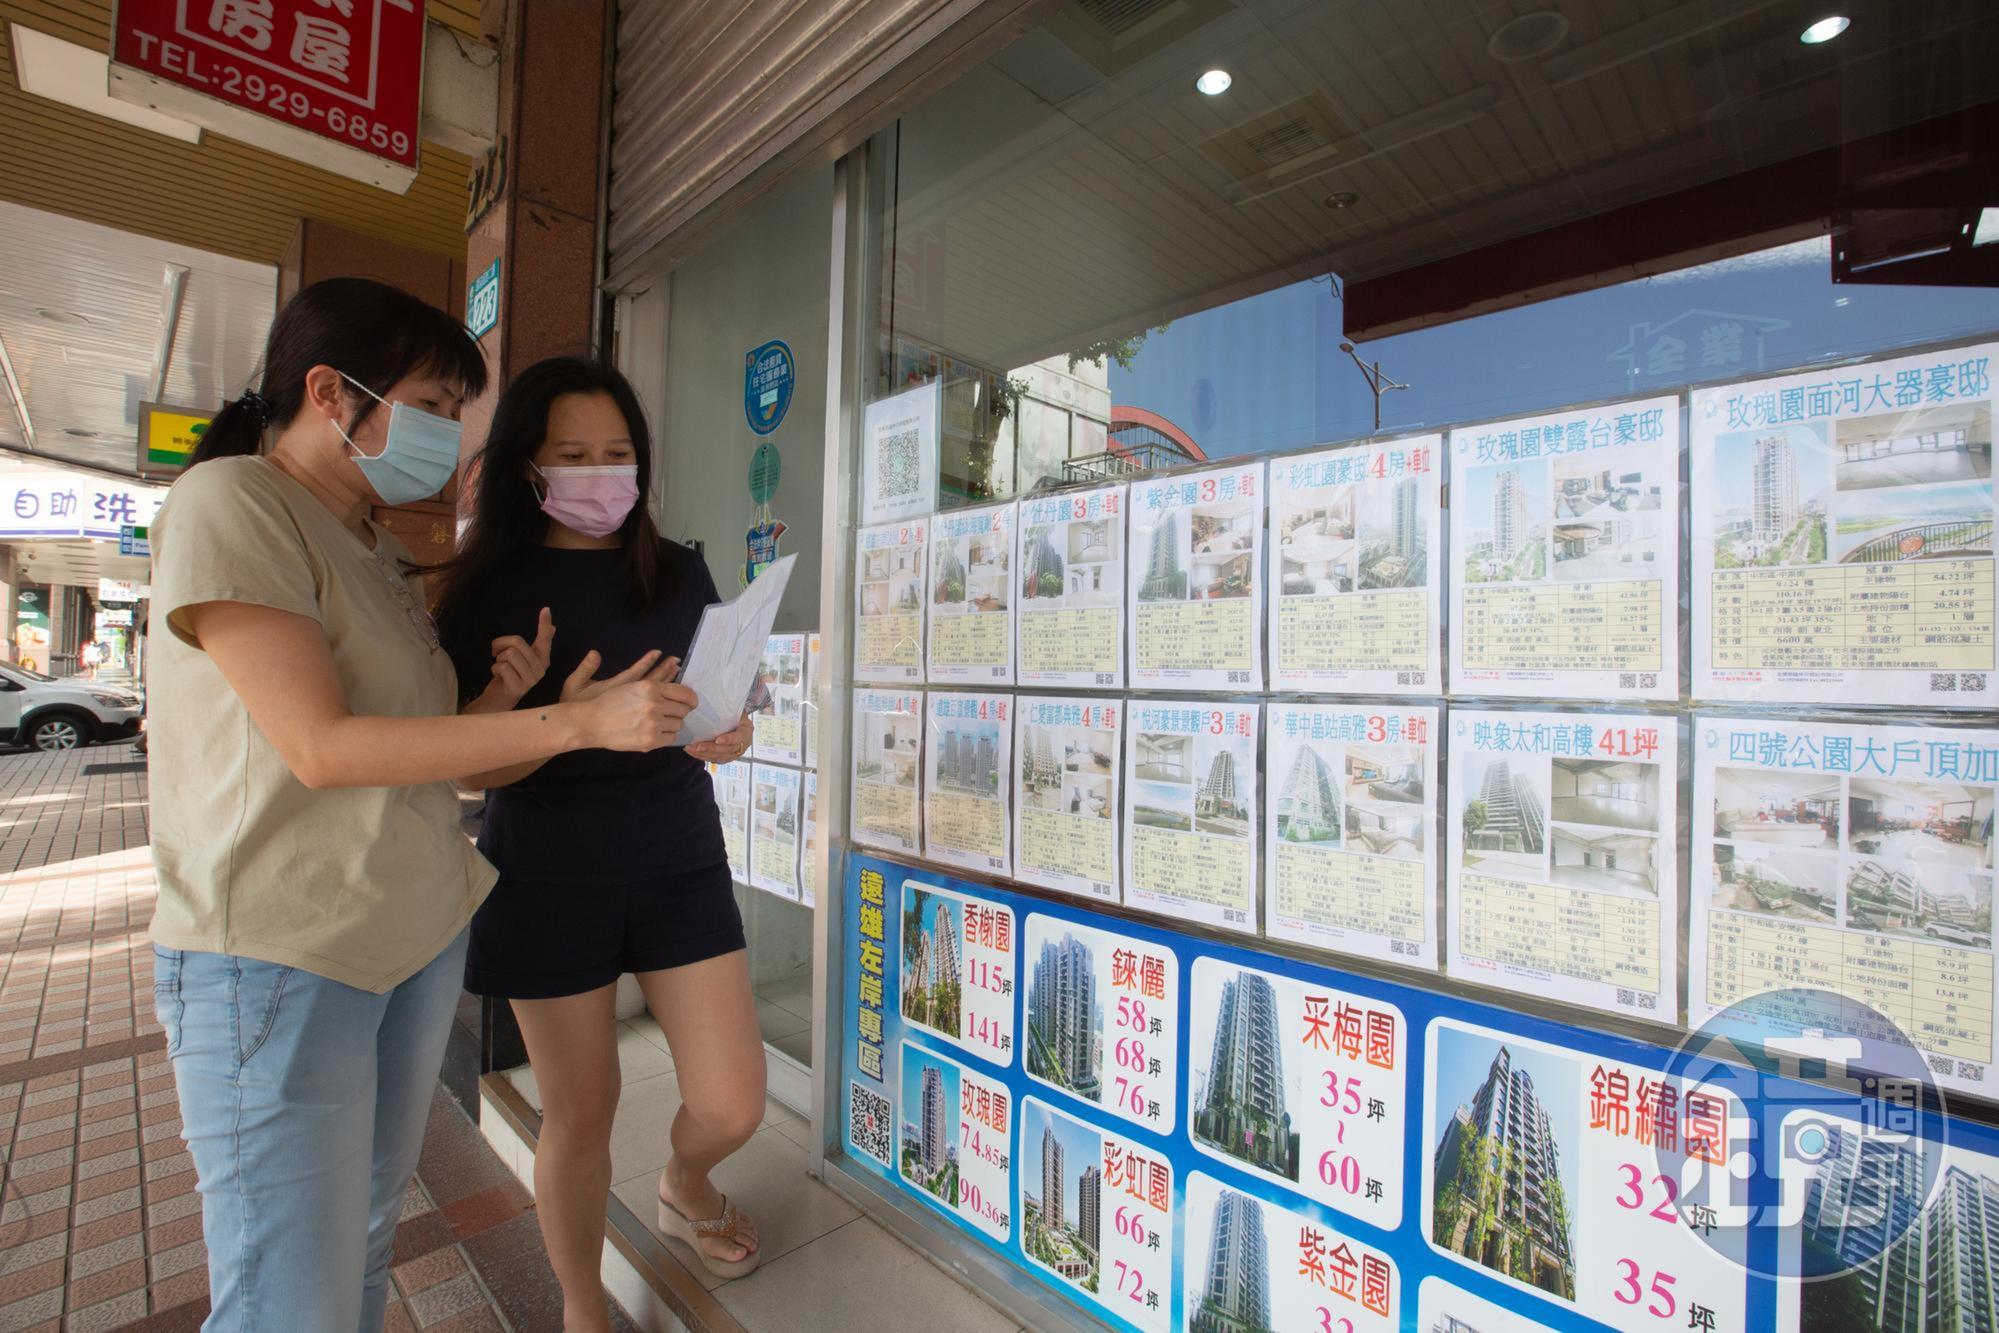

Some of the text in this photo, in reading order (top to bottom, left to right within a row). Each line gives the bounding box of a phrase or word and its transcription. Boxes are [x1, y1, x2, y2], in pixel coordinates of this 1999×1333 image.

[132, 28, 409, 156] TEL:2929-6859
[1727, 357, 1990, 430] 玫瑰園面河大器豪邸
[1476, 408, 1664, 464] 玫瑰園雙露台豪邸
[14, 488, 162, 524] 自助洗
[1473, 720, 1659, 759] 映象太和高樓 41坪
[1729, 731, 1999, 783] 四號公園大戶頂加
[964, 903, 1011, 953] 香榭園
[857, 868, 884, 1083] 遠雄左岸專區
[1111, 947, 1165, 1001] 錸儷
[1302, 995, 1395, 1071] 采梅園
[962, 1078, 1007, 1135] 玫瑰園
[1589, 1064, 1728, 1167] 錦繡園
[1103, 1141, 1169, 1213] 彩虹園
[1298, 1226, 1390, 1318] 紫金園
